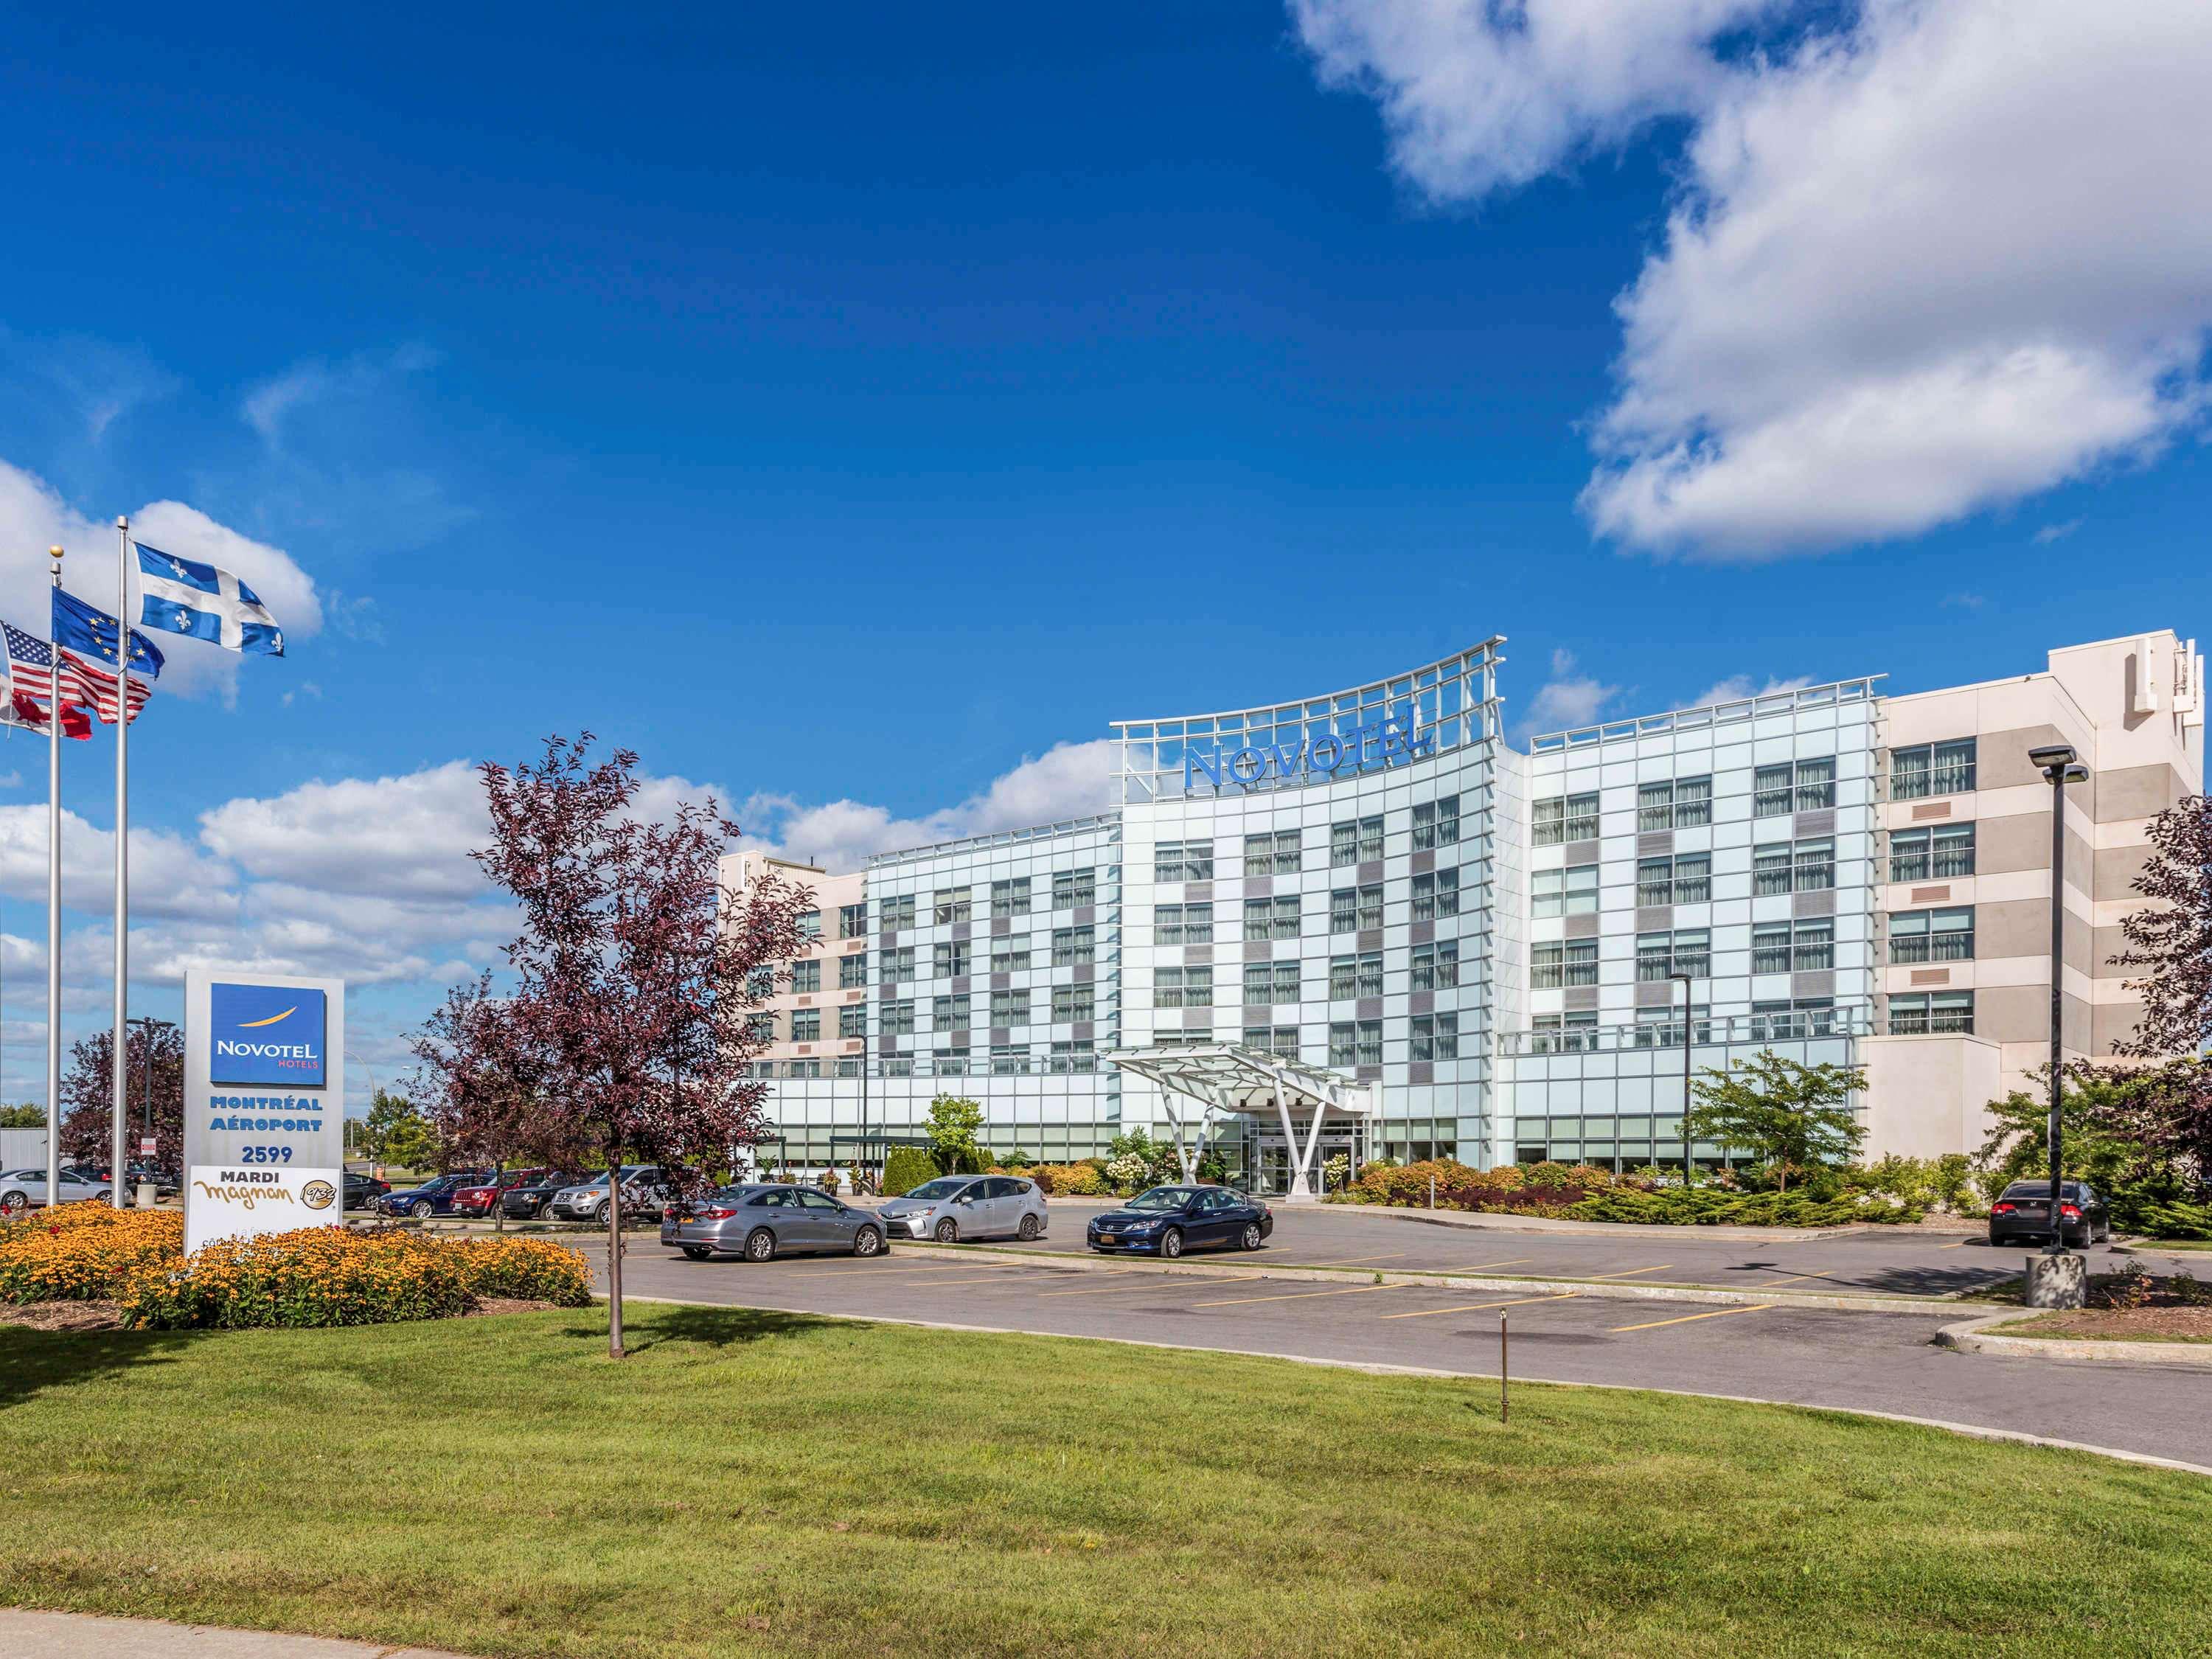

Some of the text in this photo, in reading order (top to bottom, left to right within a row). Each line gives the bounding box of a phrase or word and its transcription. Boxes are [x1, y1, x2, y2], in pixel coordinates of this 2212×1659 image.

[1183, 704, 1432, 789] NOVOTEL
[217, 1040, 318, 1059] NOVOTEL
[278, 1060, 319, 1069] HOTELS
[209, 1095, 323, 1110] MONTRÉAL
[209, 1115, 322, 1131] AÉROPORT
[242, 1146, 293, 1163] 2599
[220, 1171, 279, 1183] MARDI
[300, 1187, 336, 1200] 1932
